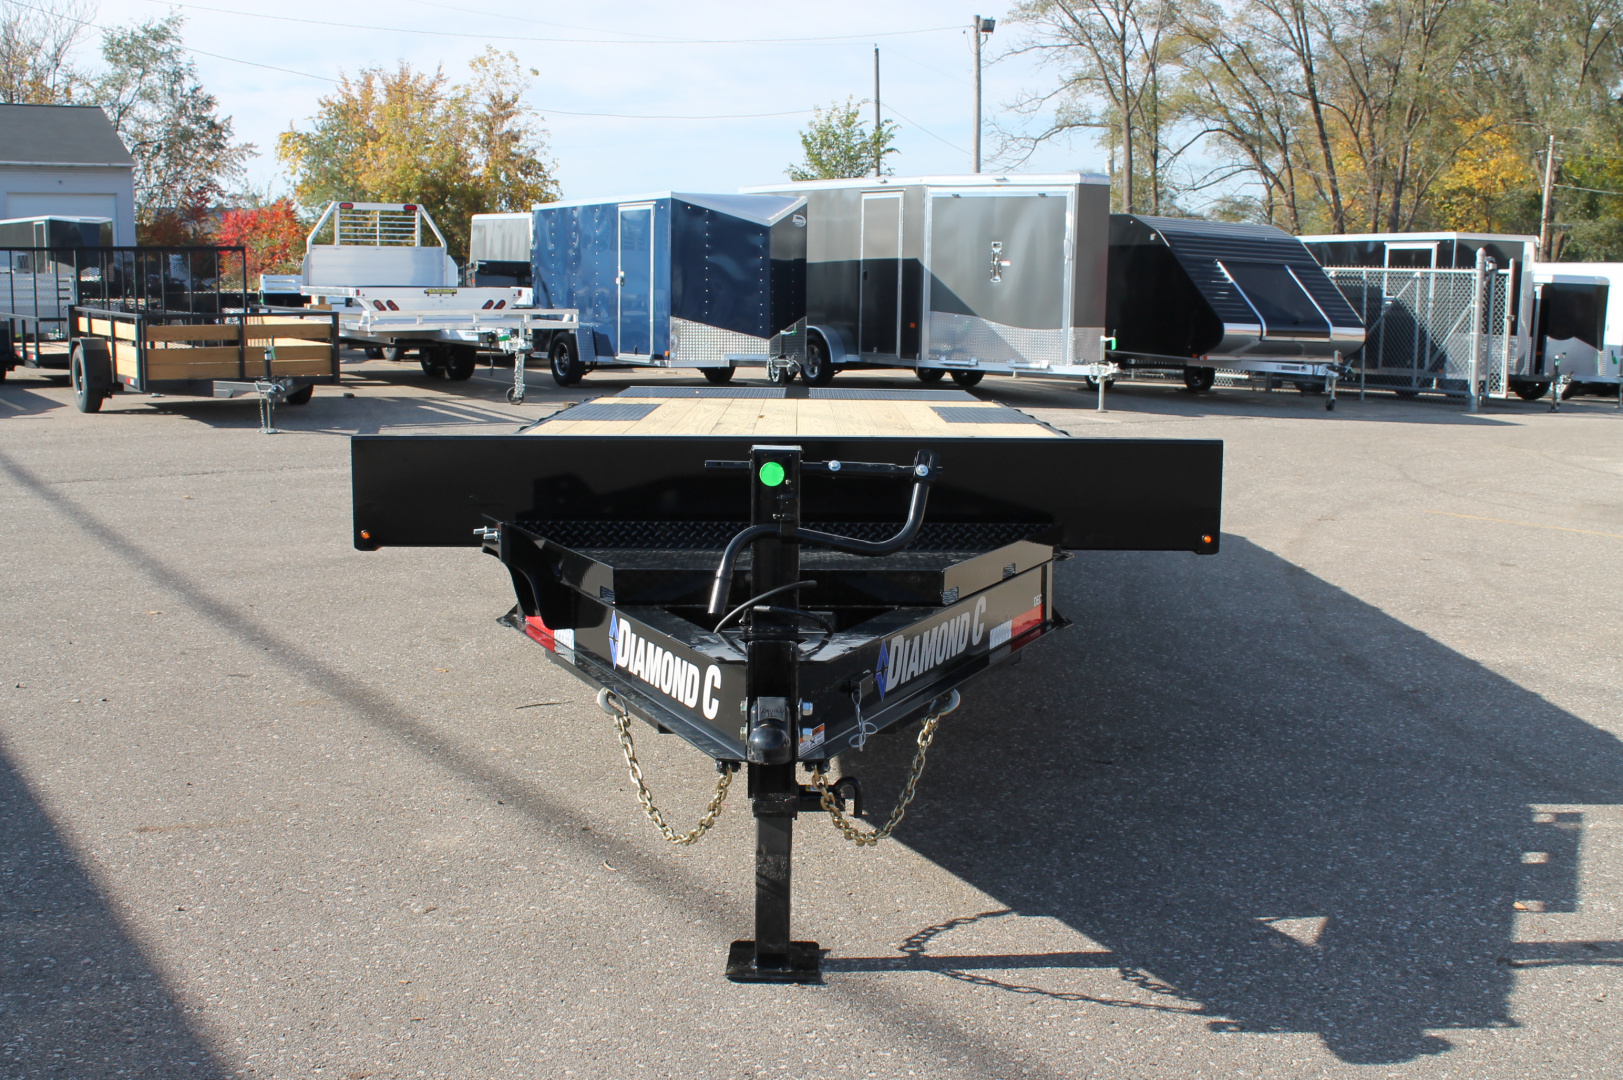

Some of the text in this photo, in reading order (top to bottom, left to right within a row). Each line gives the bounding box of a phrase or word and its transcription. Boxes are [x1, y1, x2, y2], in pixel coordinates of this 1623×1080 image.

[616, 617, 722, 720] DIAMOND C
[885, 594, 987, 693] DIAMOND C
